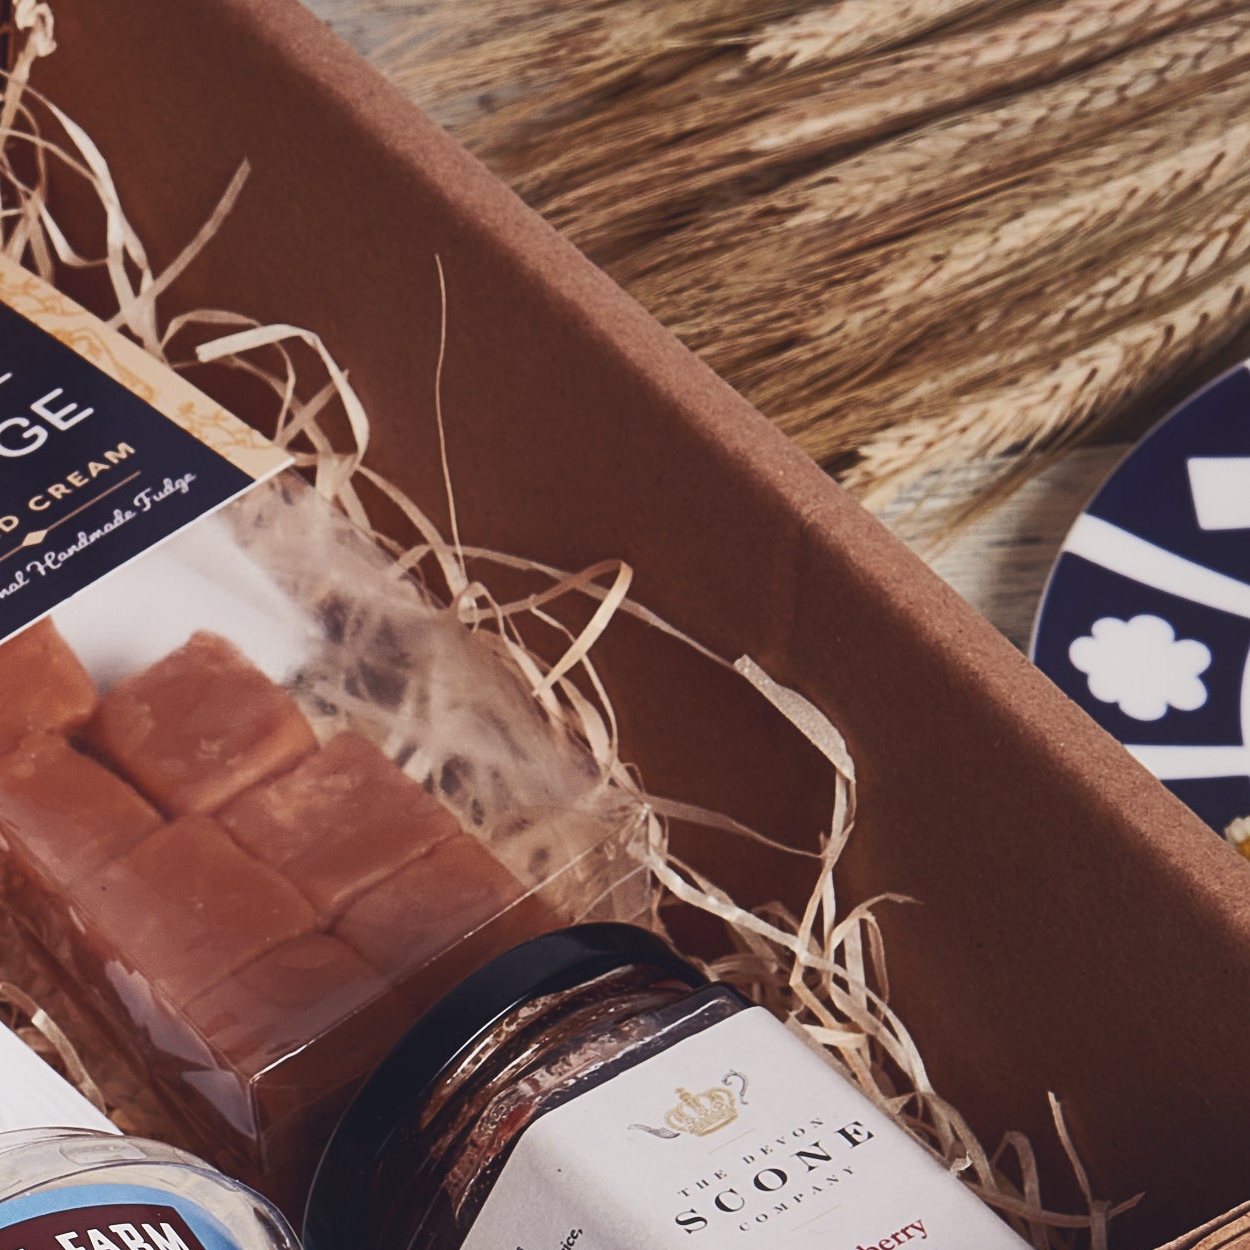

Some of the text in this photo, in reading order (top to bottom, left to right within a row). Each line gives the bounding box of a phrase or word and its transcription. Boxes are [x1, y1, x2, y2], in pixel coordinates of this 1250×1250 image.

[28, 441, 136, 512] CREAM
[27, 508, 137, 579] Handmade
[133, 471, 197, 517] Fudge
[675, 1121, 874, 1235] SCONE
[678, 1117, 824, 1198] THE DEVON
[739, 1166, 854, 1232] COMPANY
